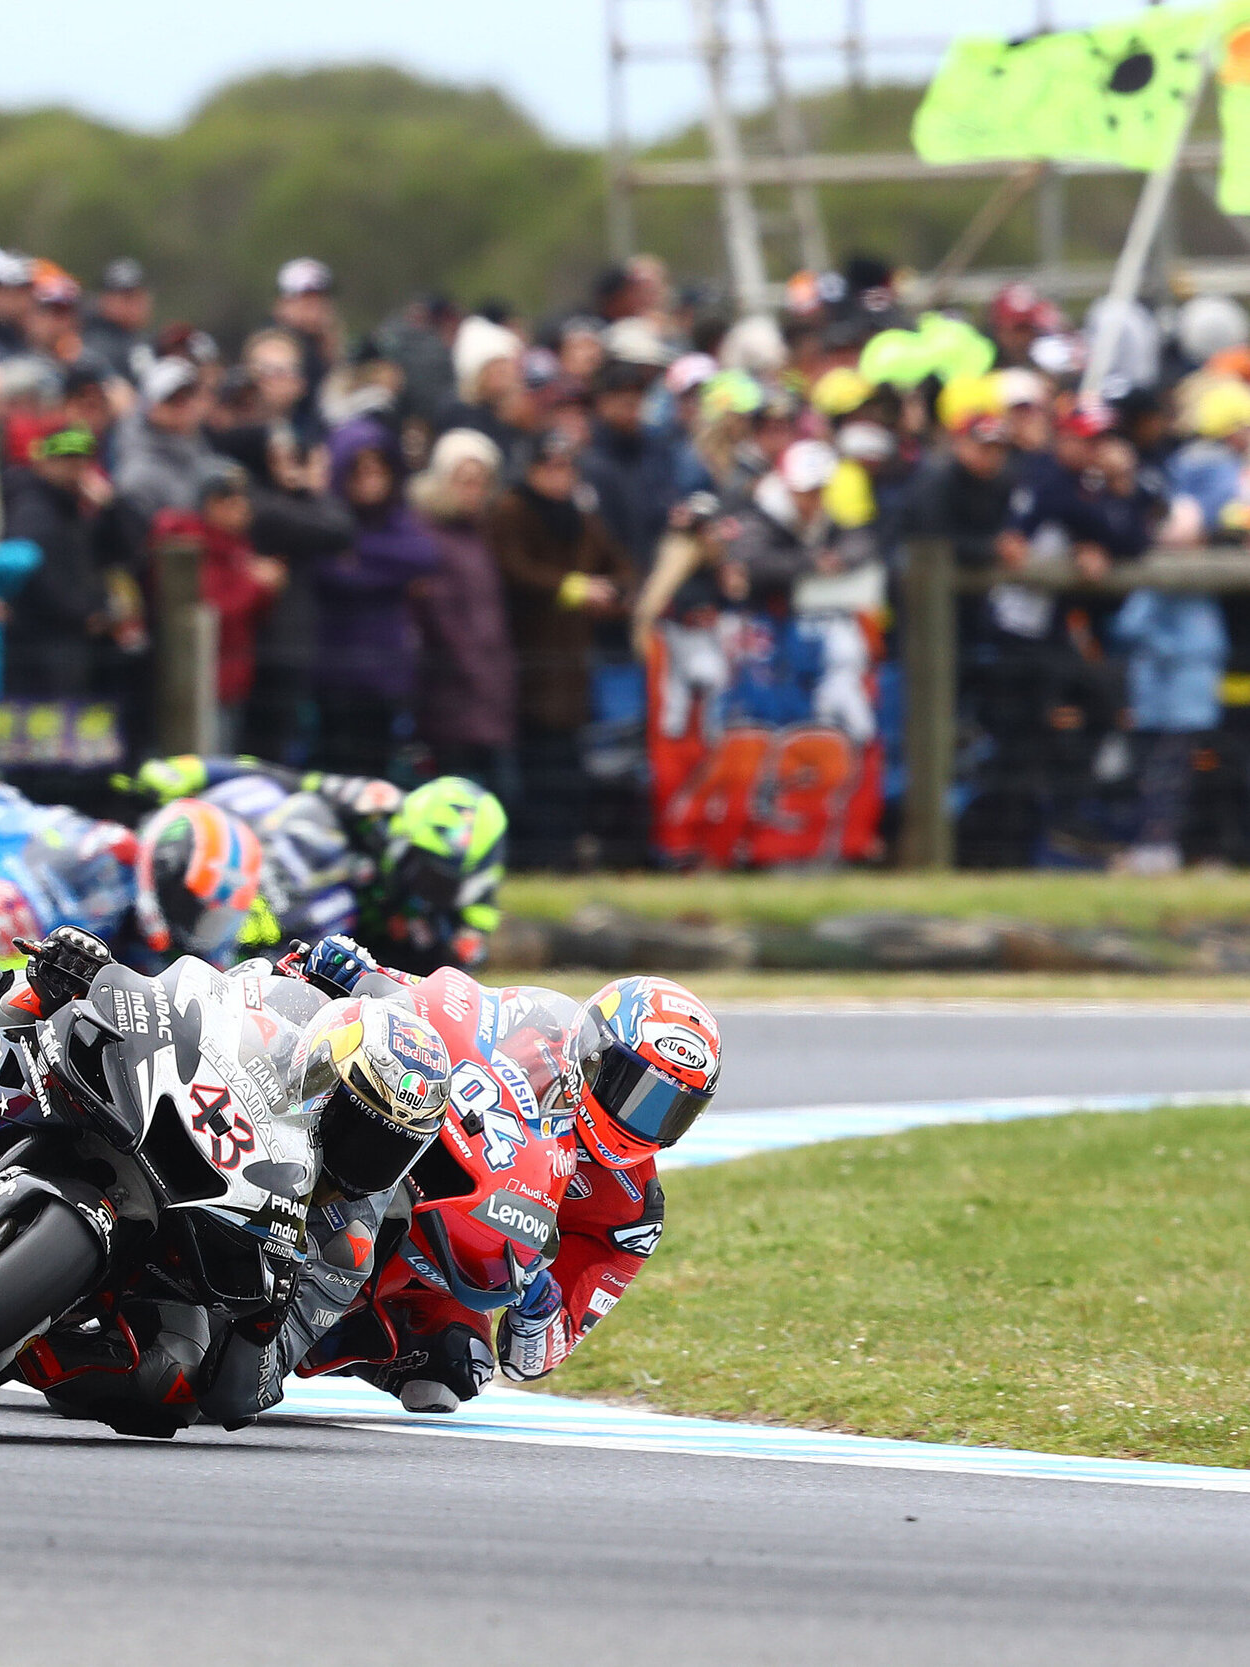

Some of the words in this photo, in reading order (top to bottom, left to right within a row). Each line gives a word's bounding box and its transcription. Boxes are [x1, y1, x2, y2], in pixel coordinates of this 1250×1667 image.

[660, 1036, 703, 1068] SUOMY
[245, 1055, 285, 1108] FIAMM
[490, 1058, 535, 1115] valsir
[190, 1083, 256, 1170] 43
[349, 1093, 378, 1120] GIVES
[381, 1116, 403, 1134] YOU
[443, 1117, 474, 1159] DUCATI
[450, 1058, 528, 1173] 04
[519, 1184, 542, 1201] Audi
[486, 1194, 549, 1243] Lenovo
